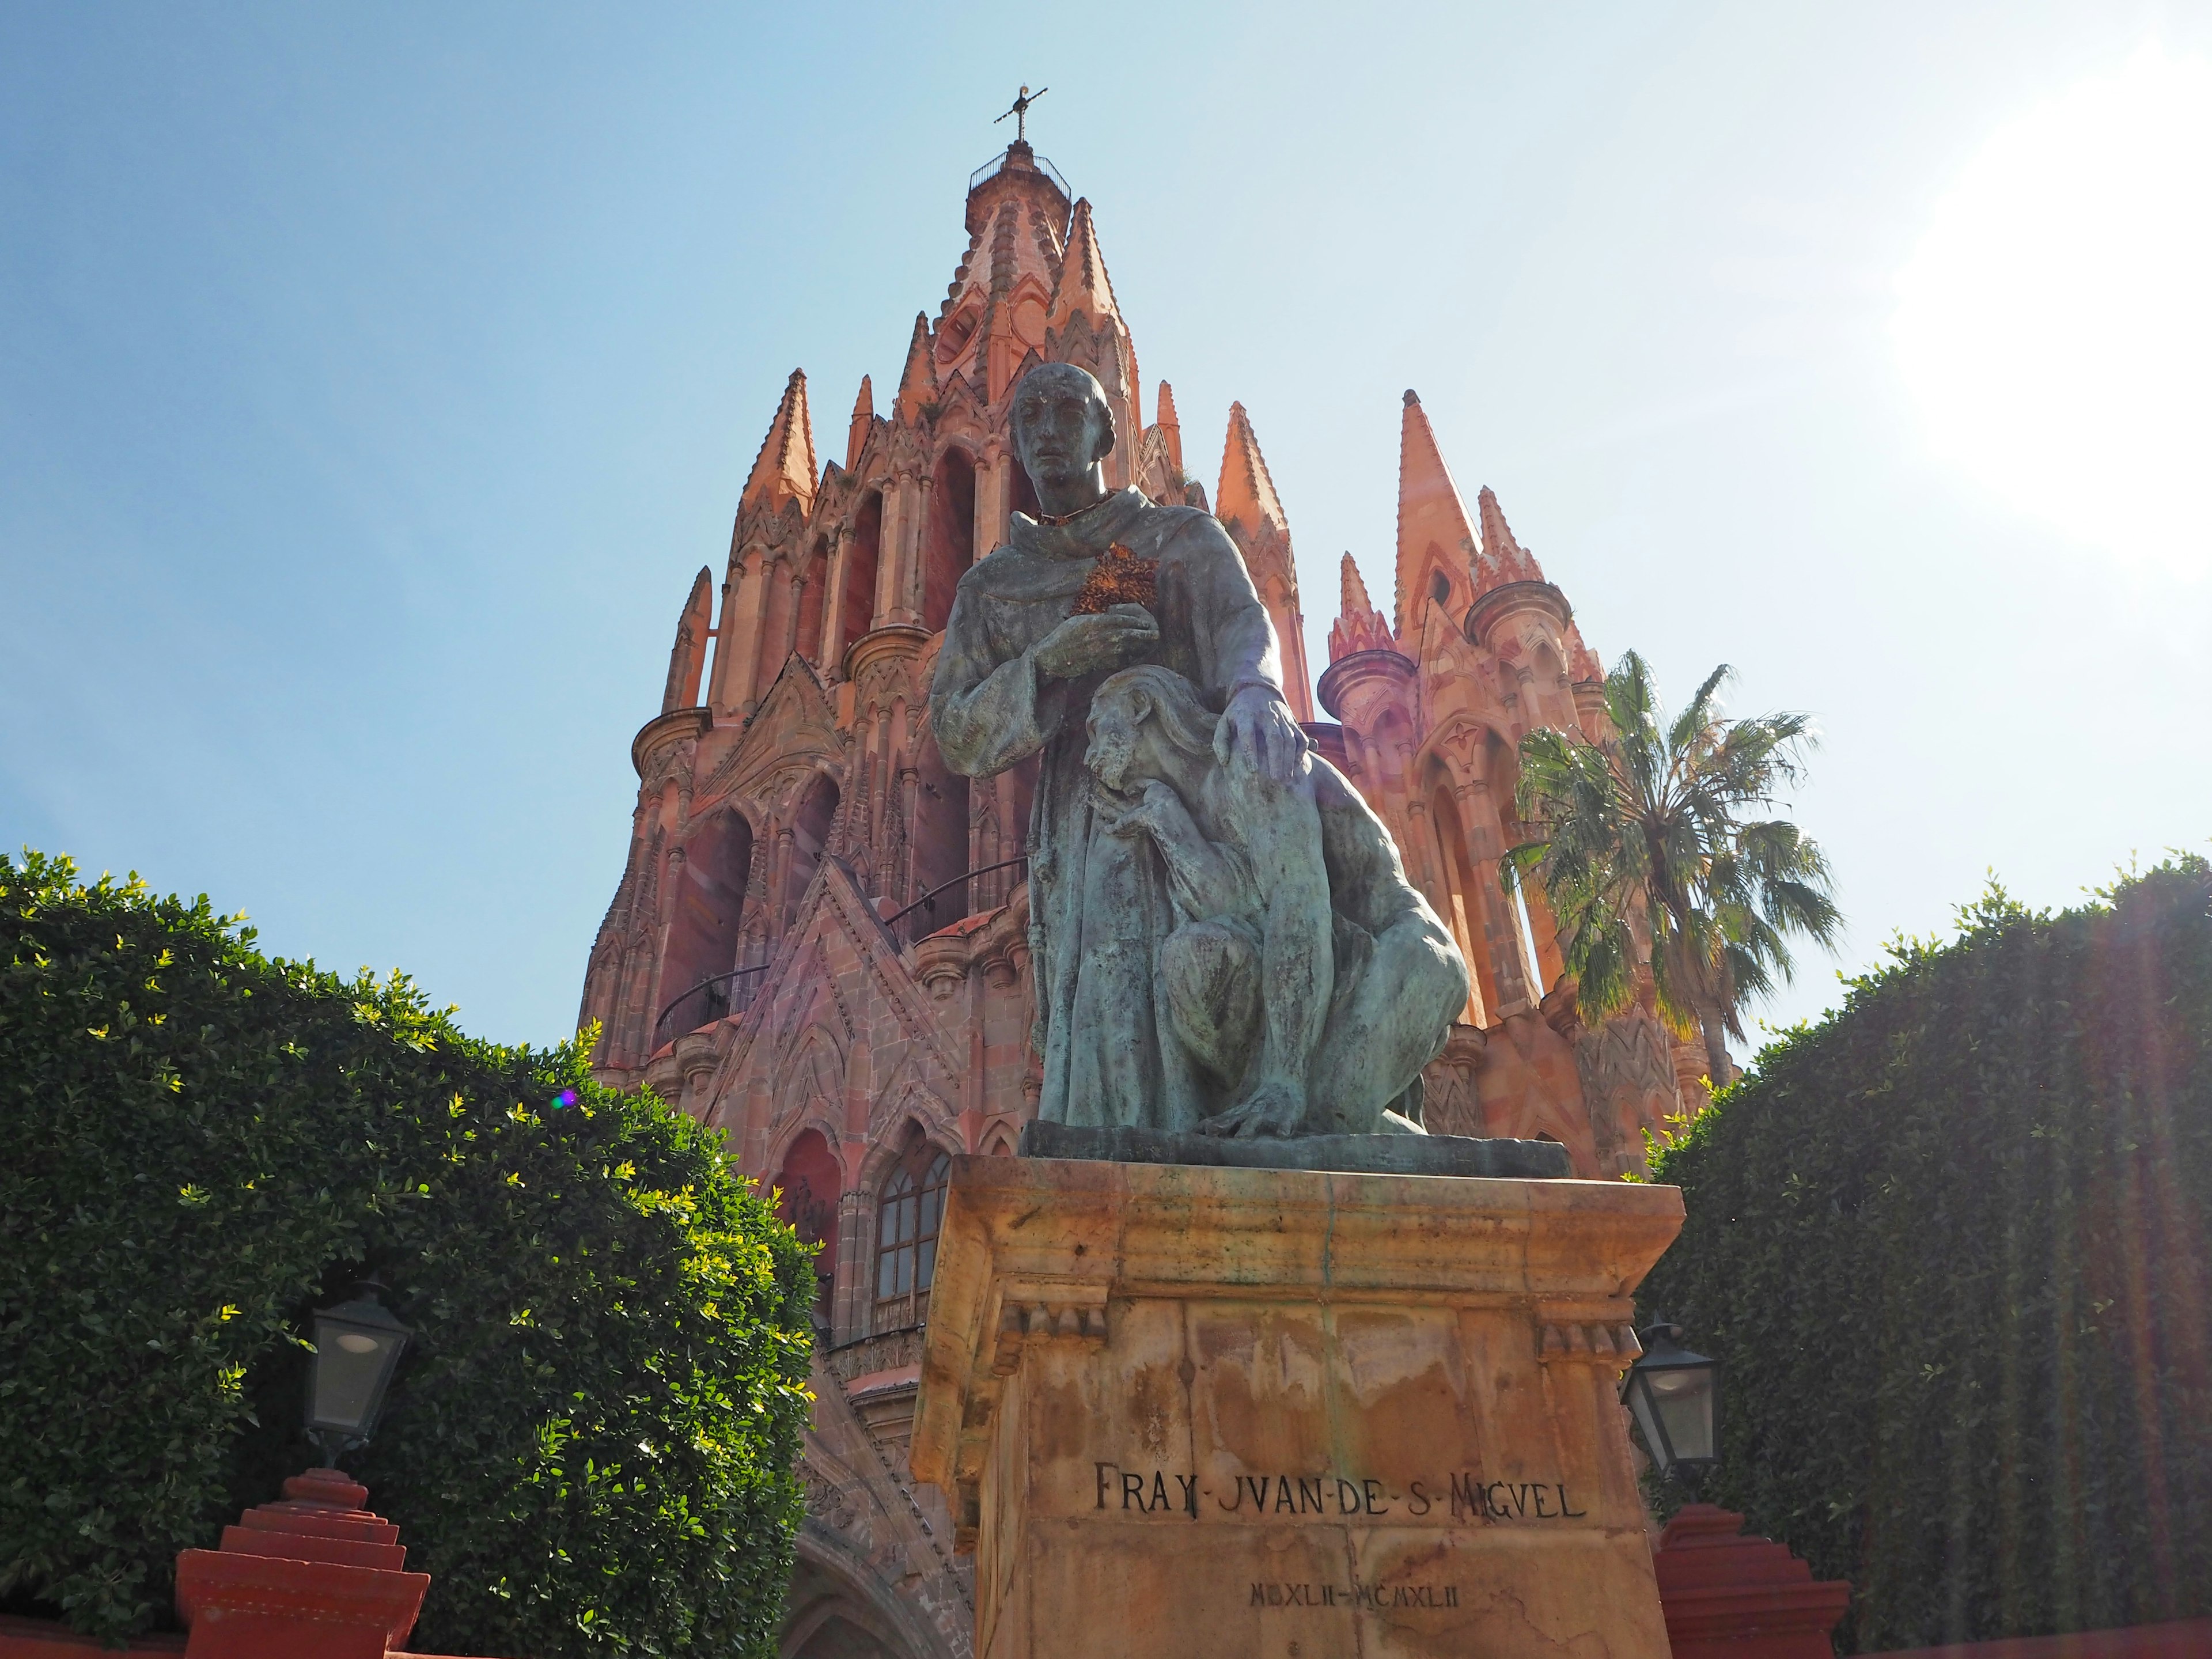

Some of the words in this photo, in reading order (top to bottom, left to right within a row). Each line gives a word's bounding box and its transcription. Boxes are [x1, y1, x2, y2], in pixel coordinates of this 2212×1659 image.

[1094, 1461, 1197, 1520] FRAY
[1218, 1475, 1324, 1514] JVAN
[1336, 1479, 1389, 1515] DE
[1407, 1481, 1432, 1516] S
